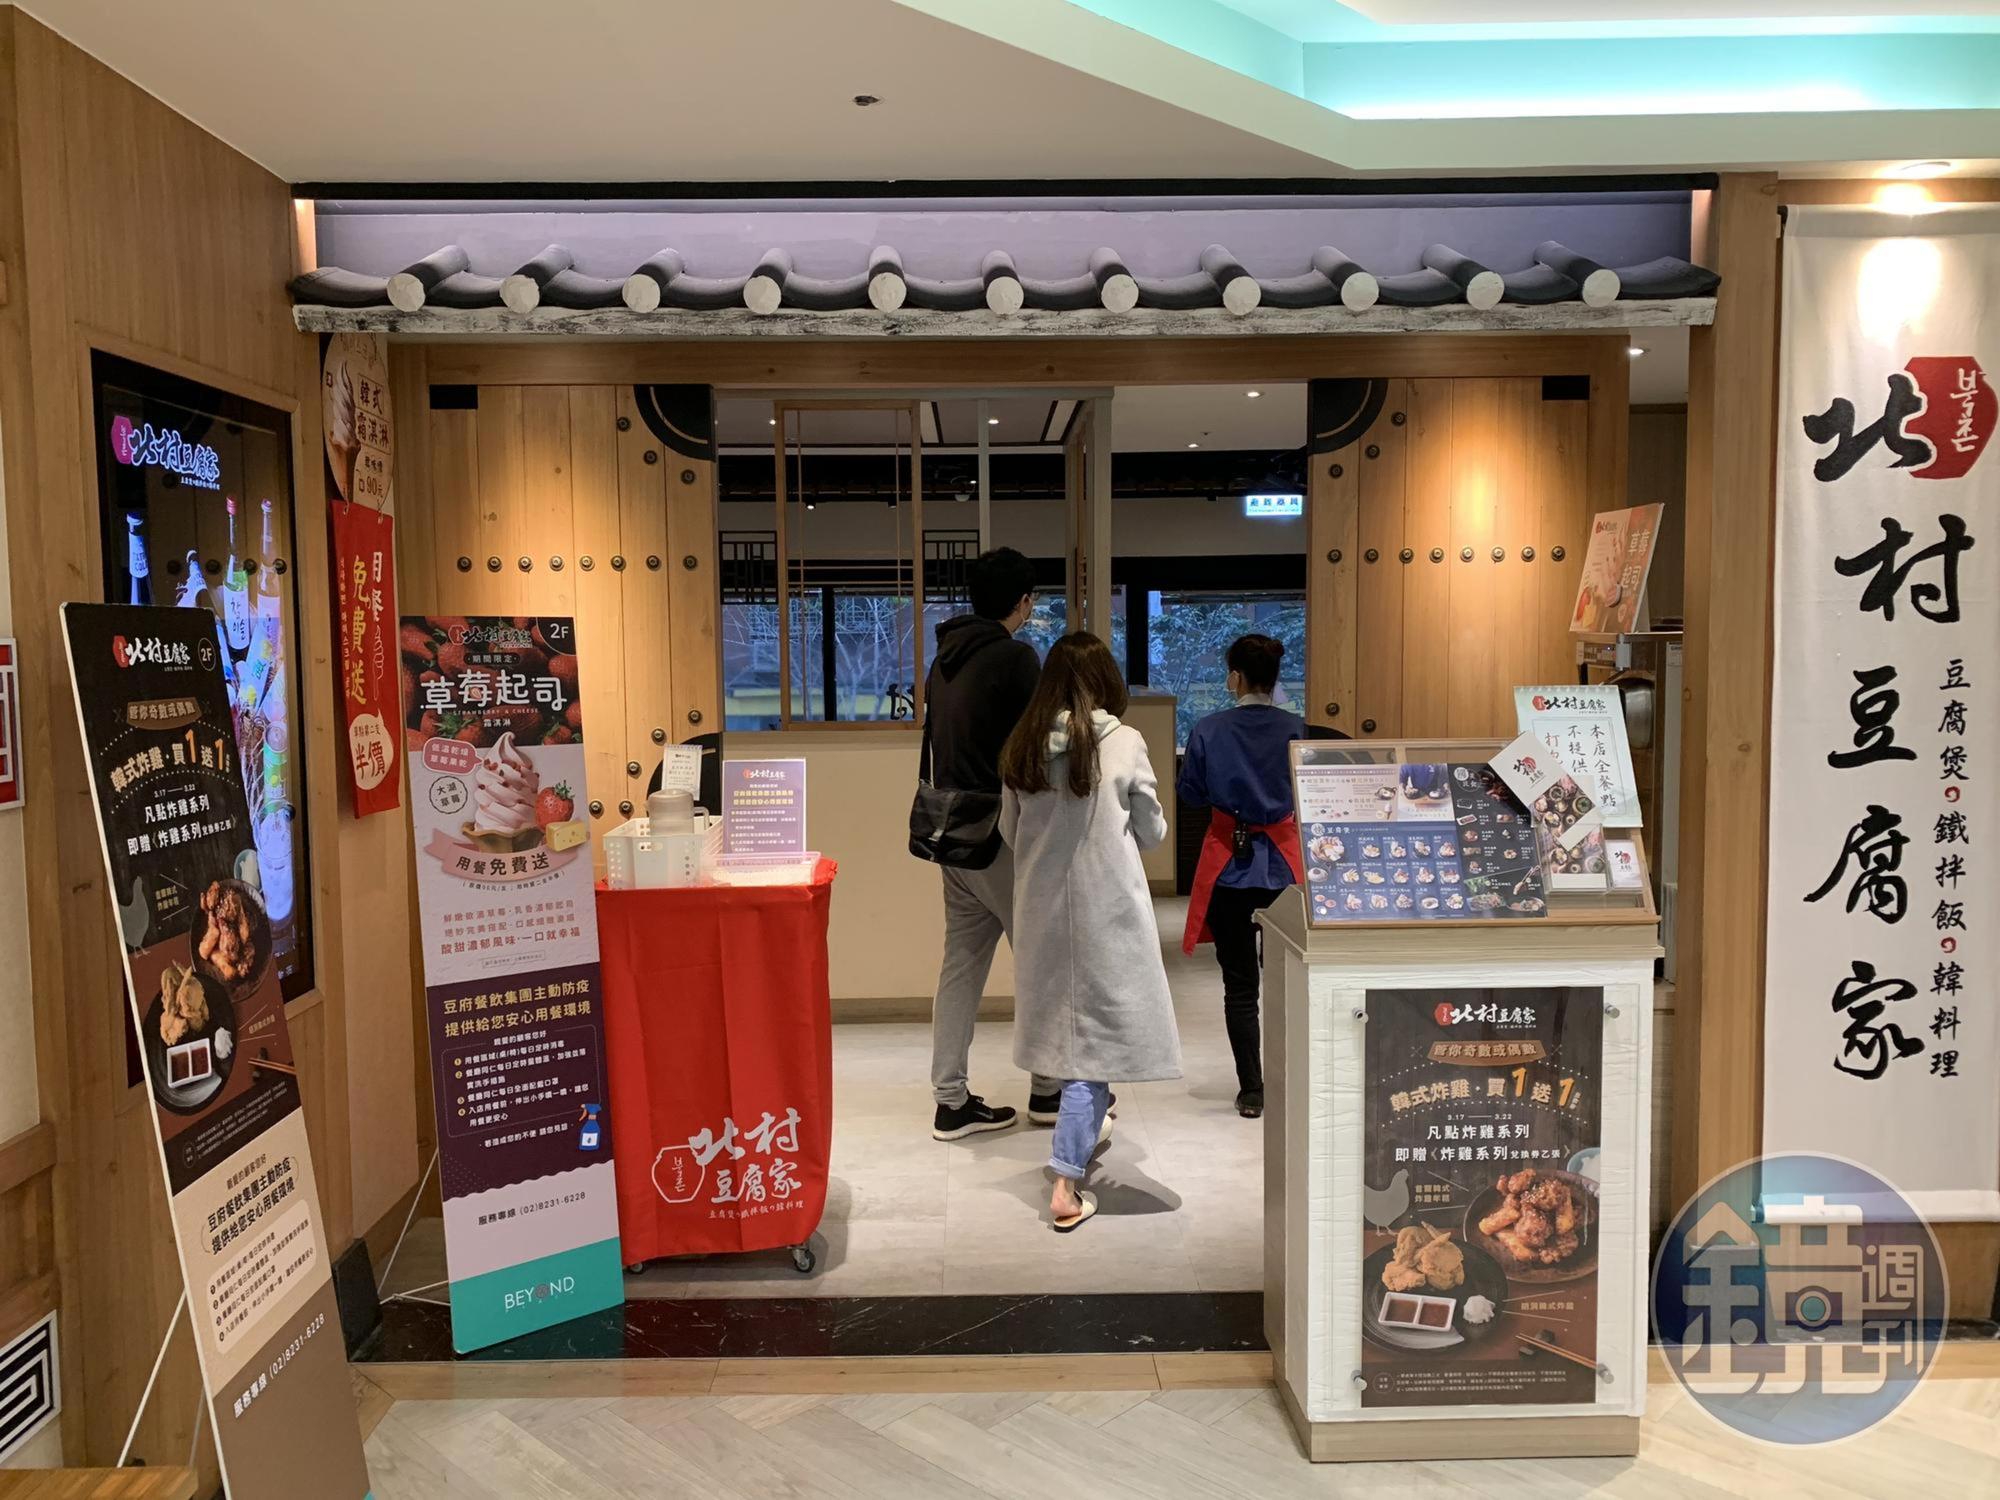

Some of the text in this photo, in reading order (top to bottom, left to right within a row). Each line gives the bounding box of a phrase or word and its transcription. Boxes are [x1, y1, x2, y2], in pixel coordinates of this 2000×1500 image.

[1949, 368, 1986, 453] 북촌
[550, 623, 569, 640] 2F
[125, 636, 191, 666] 北村豆腐家
[201, 648, 213, 662] 2F
[420, 668, 568, 715] 草莓起司
[1545, 696, 1607, 711] 北村豆腐家
[1802, 373, 1976, 1081] 北村豆腐家
[356, 741, 386, 780] 半價
[1568, 724, 1589, 774] 不提供
[1589, 724, 1616, 808] 本店全餐點
[144, 794, 210, 824] 凡點炸雞系列
[455, 851, 550, 876] 用餐免費送
[1928, 658, 1971, 1079] 豆腐煲 鐵拌飯 韓料理
[443, 978, 591, 1015] 豆府餐飲集團主動防疫
[1450, 1003, 1537, 1025] 北村豆腐家
[444, 1000, 592, 1038] 提供給您安心用餐環境
[688, 1107, 802, 1166] 北村
[1427, 1123, 1530, 1141] 凡點炸雞系列
[710, 1158, 802, 1204] 豆腐家
[519, 1191, 586, 1216] (02)8231-6228
